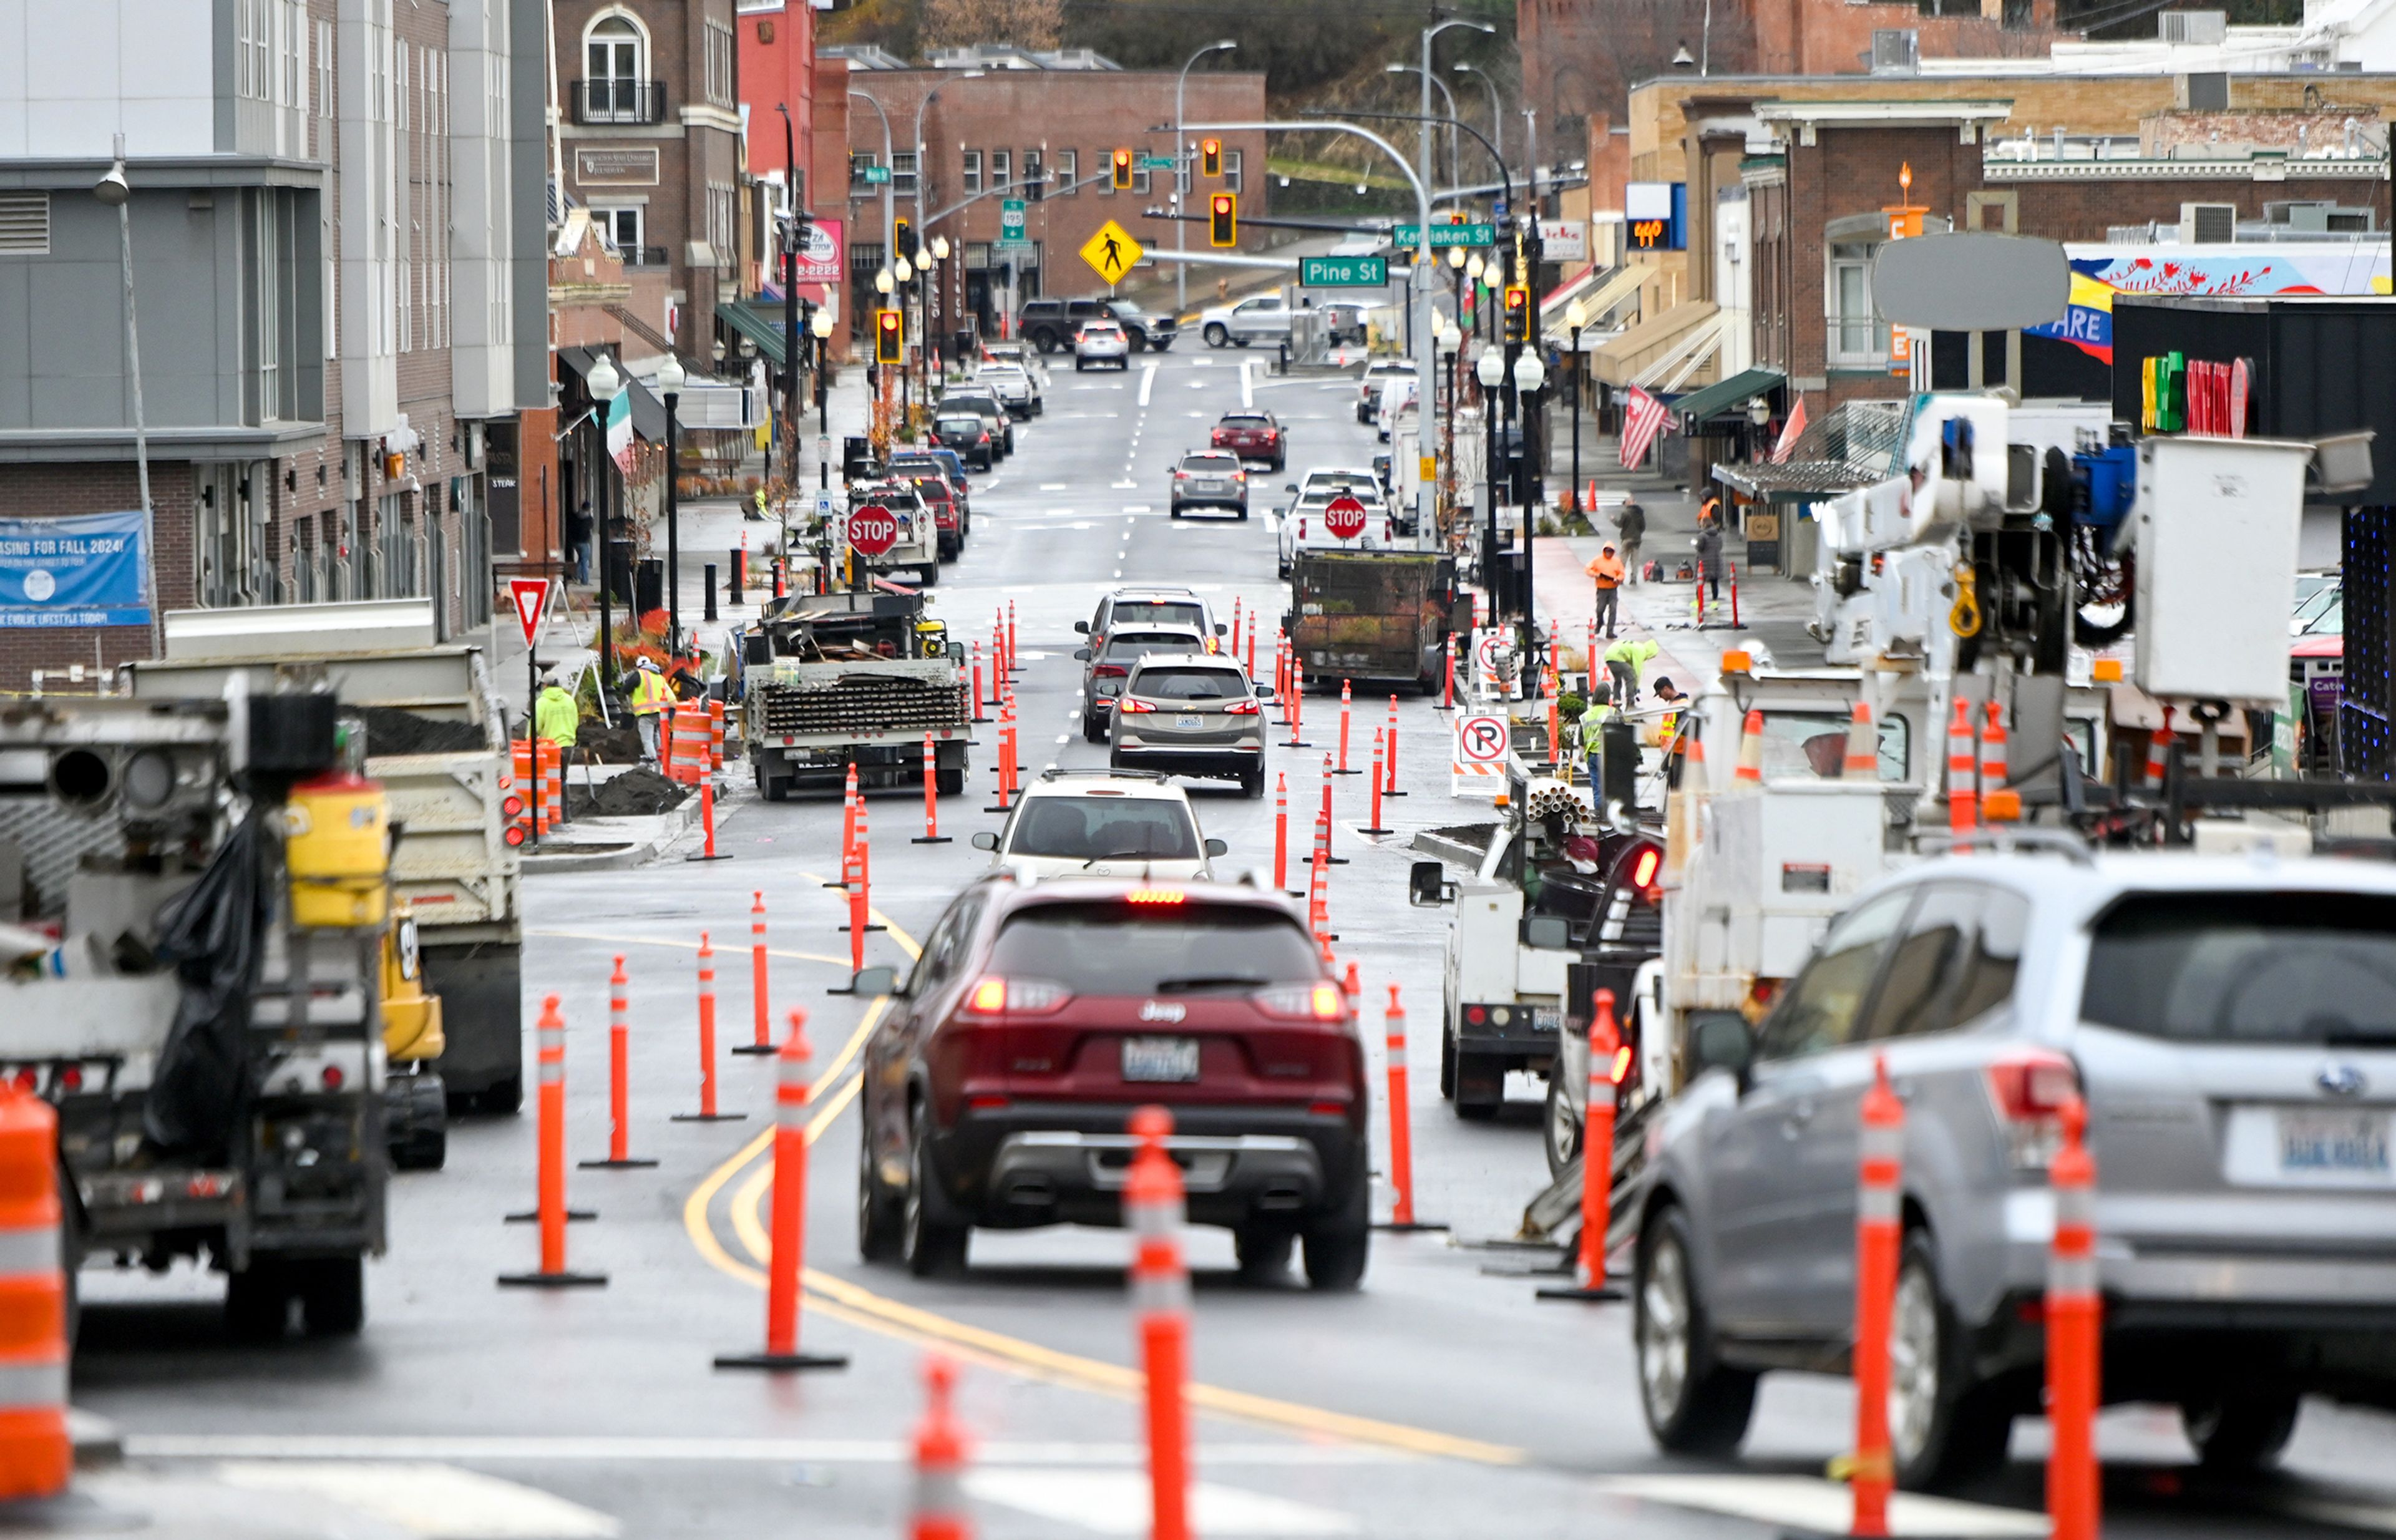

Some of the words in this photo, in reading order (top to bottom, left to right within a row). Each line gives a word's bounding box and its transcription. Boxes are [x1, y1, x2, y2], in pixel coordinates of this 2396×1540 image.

[1006, 214, 1022, 224] 195
[1476, 229, 1490, 243] St
[1310, 262, 1351, 280] Pine
[1360, 263, 1378, 280] St
[1327, 509, 1365, 527] STOP
[851, 520, 894, 542] STOP
[34, 540, 56, 555] FOR
[59, 539, 87, 554] FALL
[90, 539, 124, 553] 2024!
[1476, 726, 1497, 751] P
[1137, 998, 1187, 1025] Jeep
